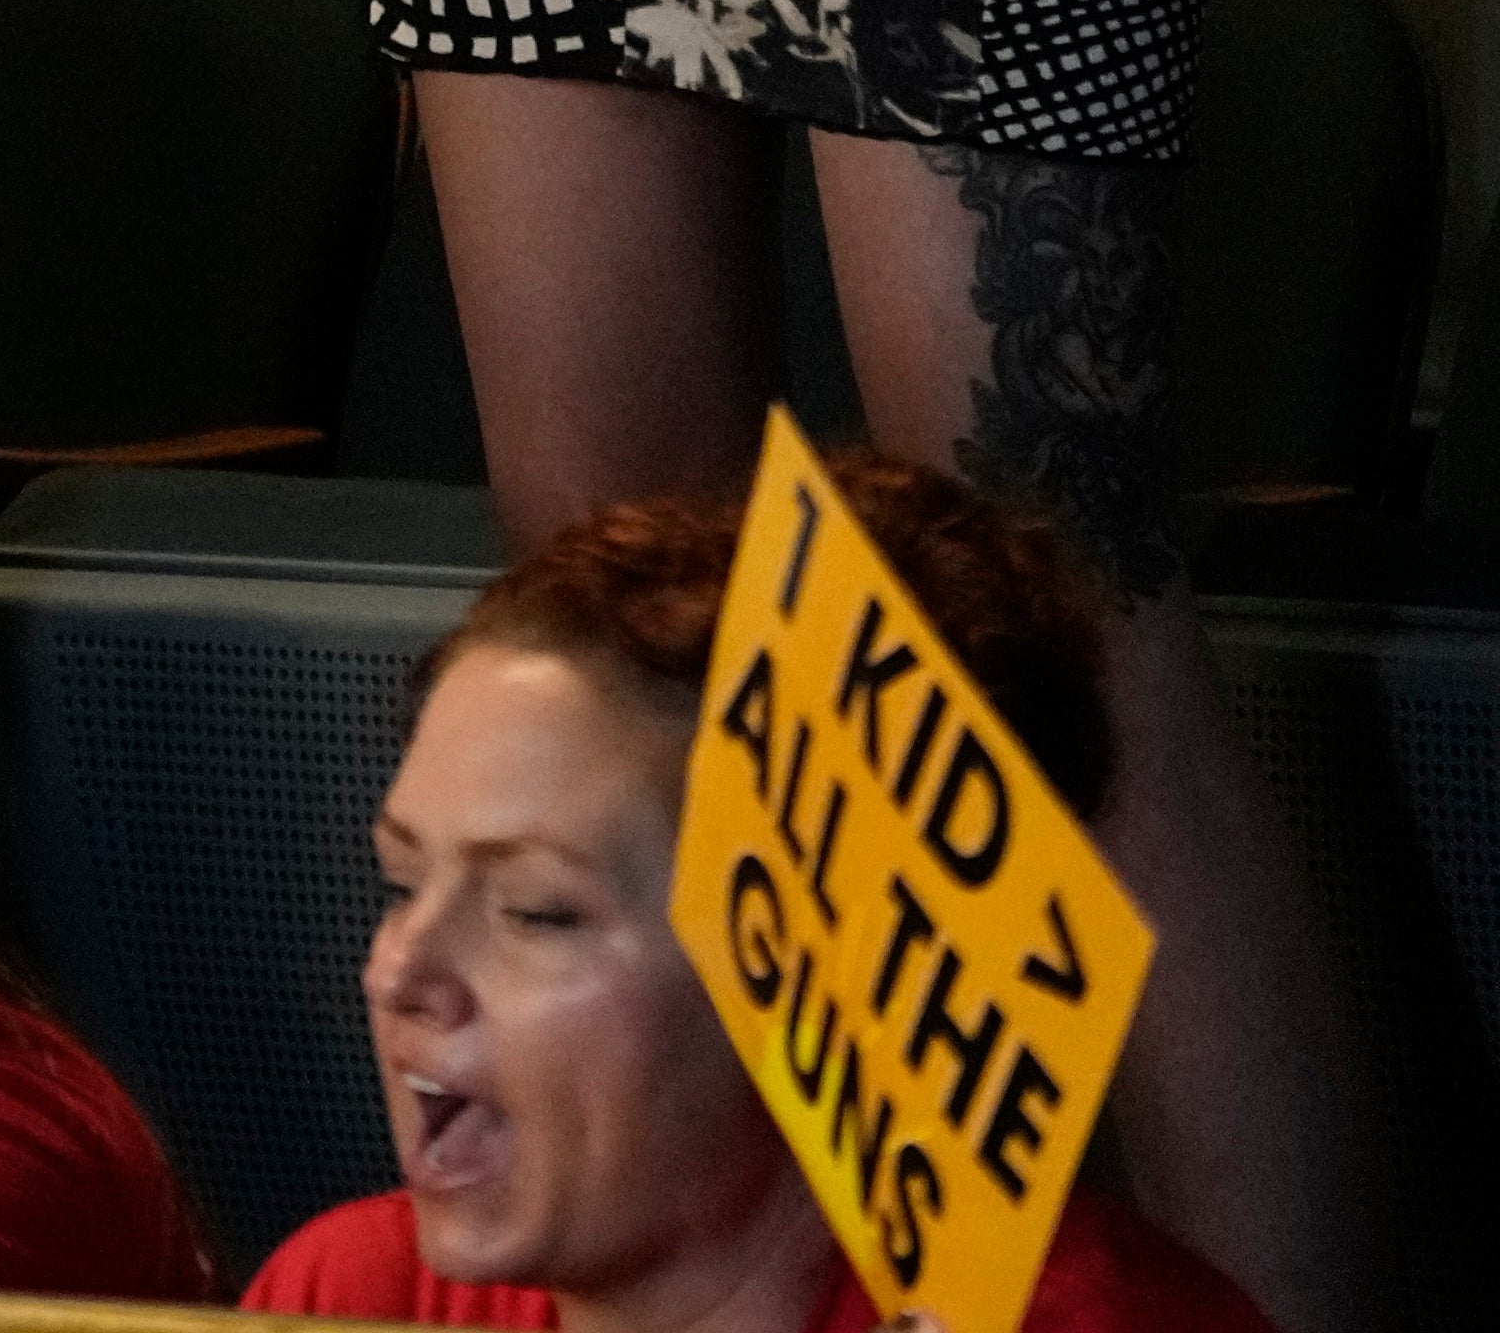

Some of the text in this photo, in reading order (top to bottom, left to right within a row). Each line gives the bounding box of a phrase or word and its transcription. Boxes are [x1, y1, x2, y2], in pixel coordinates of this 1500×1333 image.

[779, 482, 821, 617] 1
[838, 599, 1012, 889] KID
[719, 651, 1062, 1201] ALL THE
[728, 855, 944, 1289] GUNS
